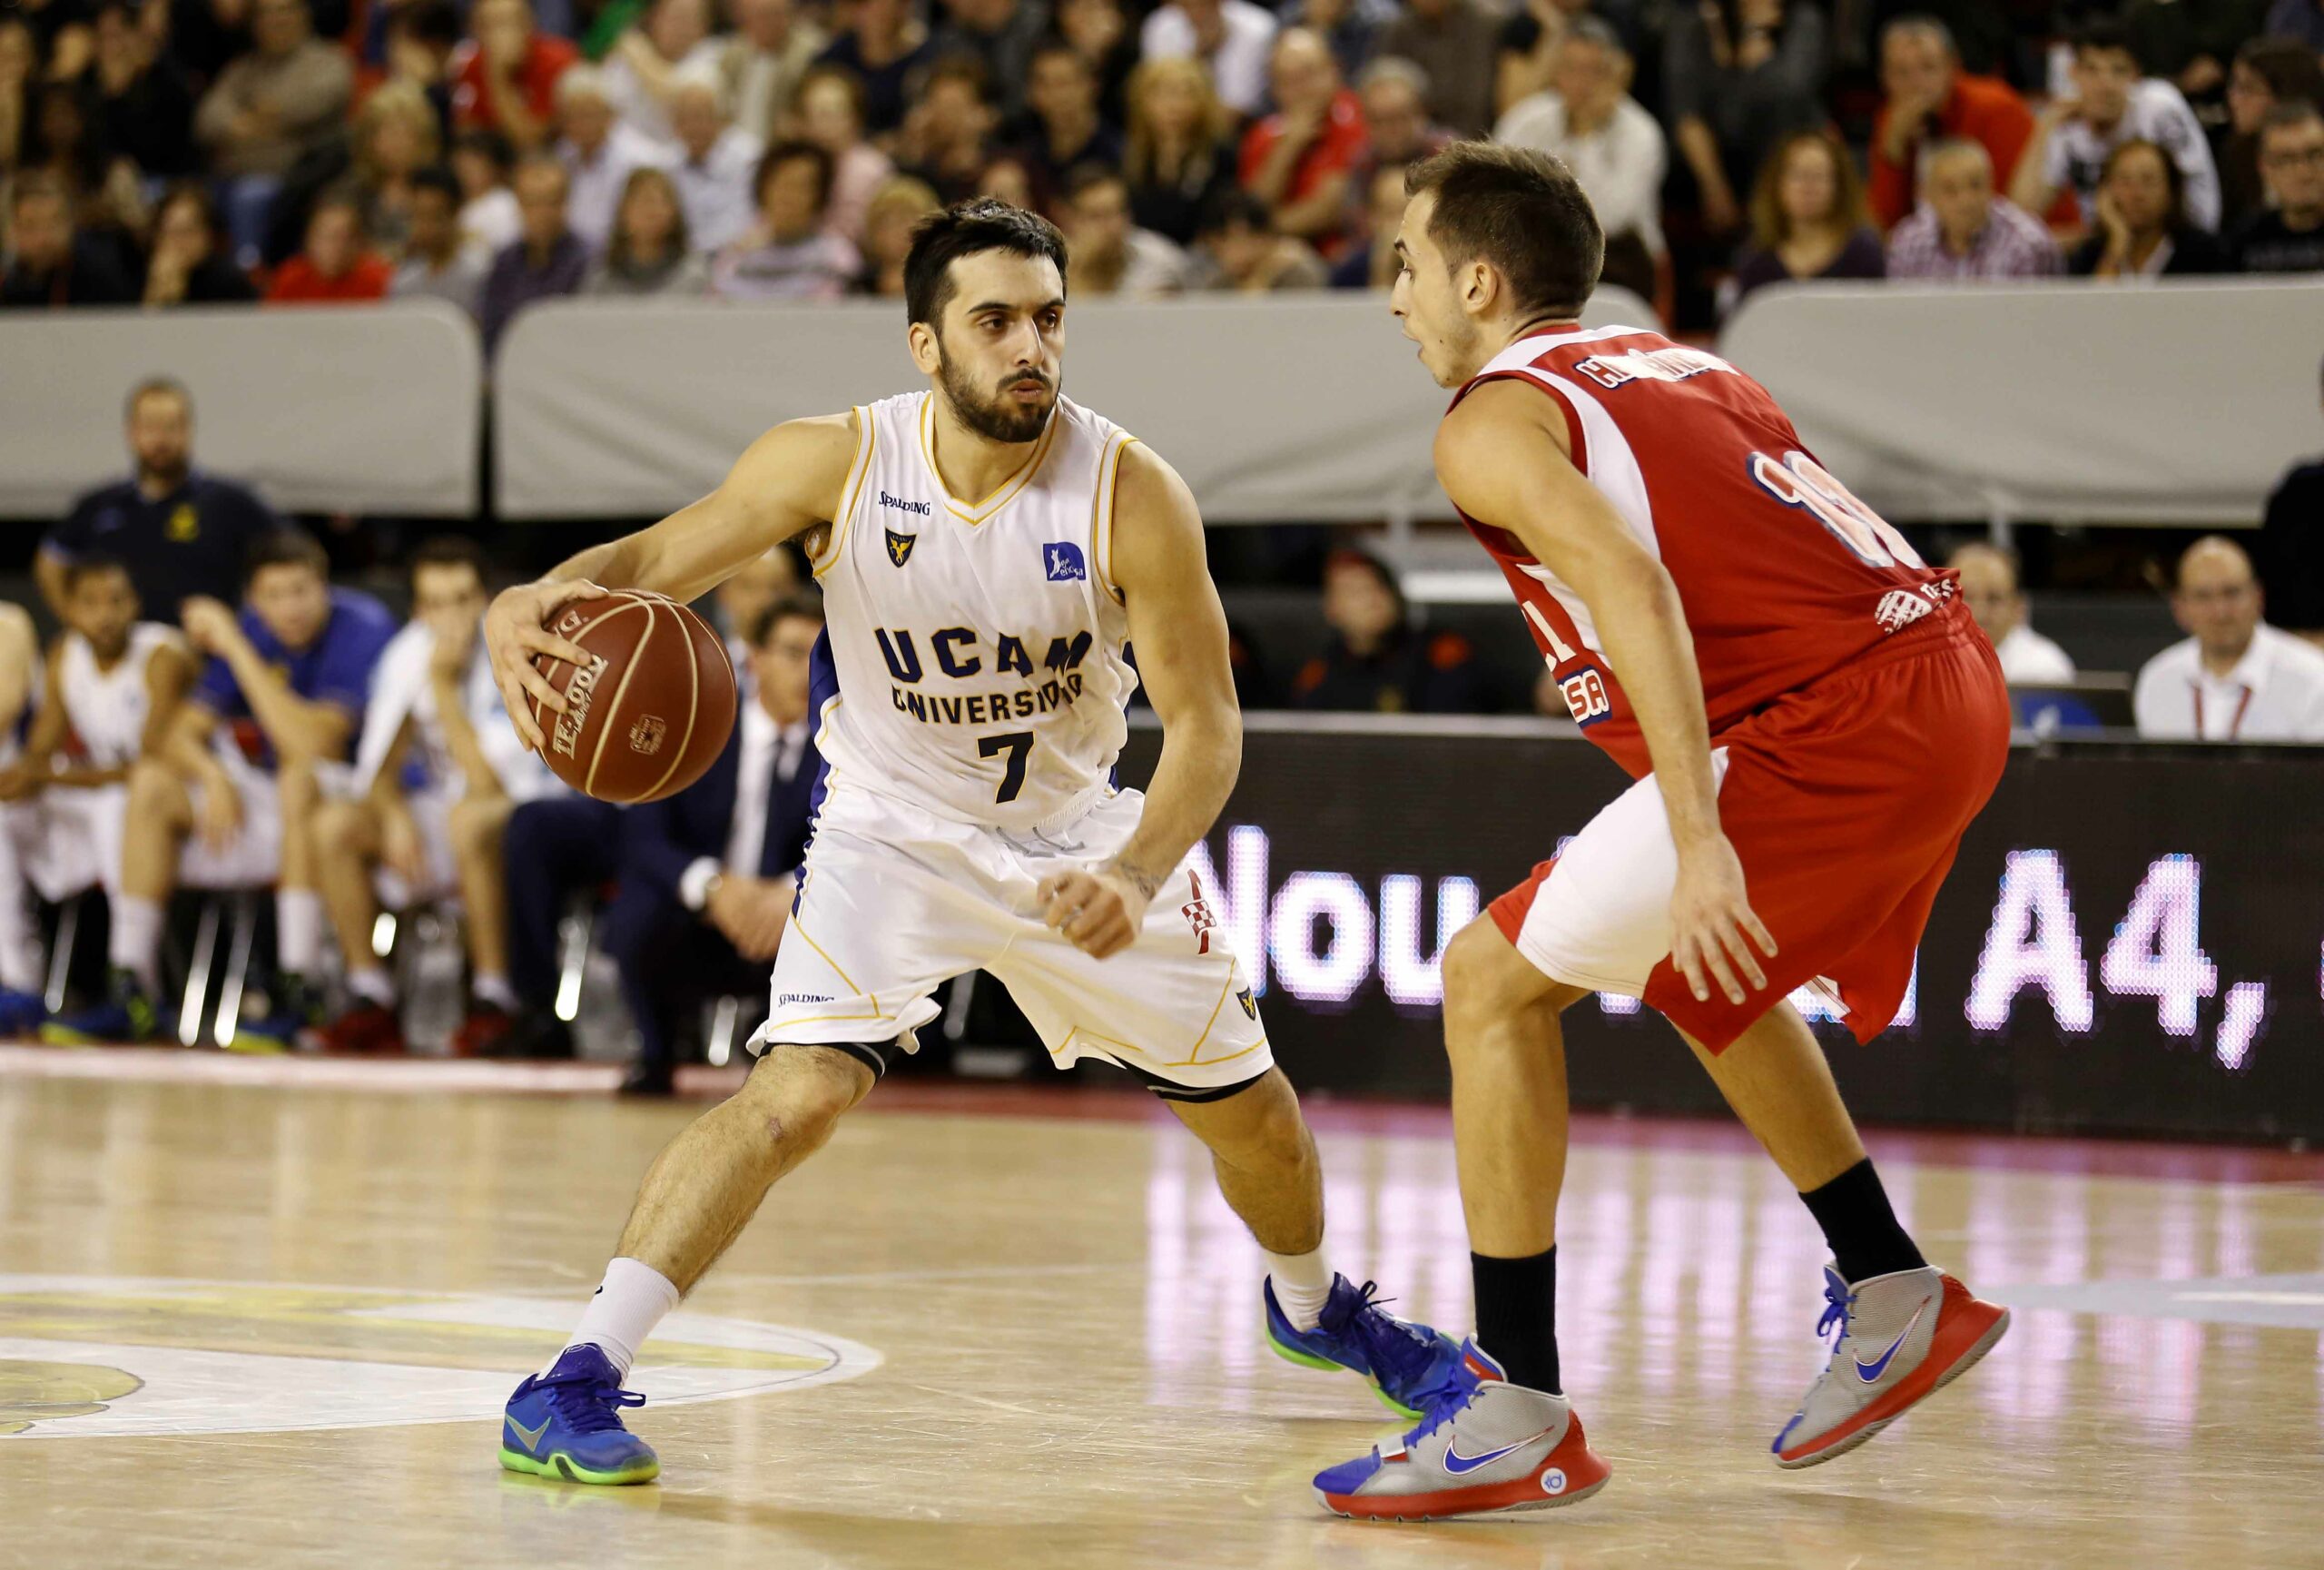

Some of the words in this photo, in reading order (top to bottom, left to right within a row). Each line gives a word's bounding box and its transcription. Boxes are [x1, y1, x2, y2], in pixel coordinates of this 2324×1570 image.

[878, 490, 931, 516] SPALDING
[873, 627, 1093, 684] UCAM
[1557, 667, 1613, 726] SA
[977, 730, 1035, 805] 7
[1189, 824, 1480, 1006] Nou
[1965, 849, 2266, 1070] A4,
